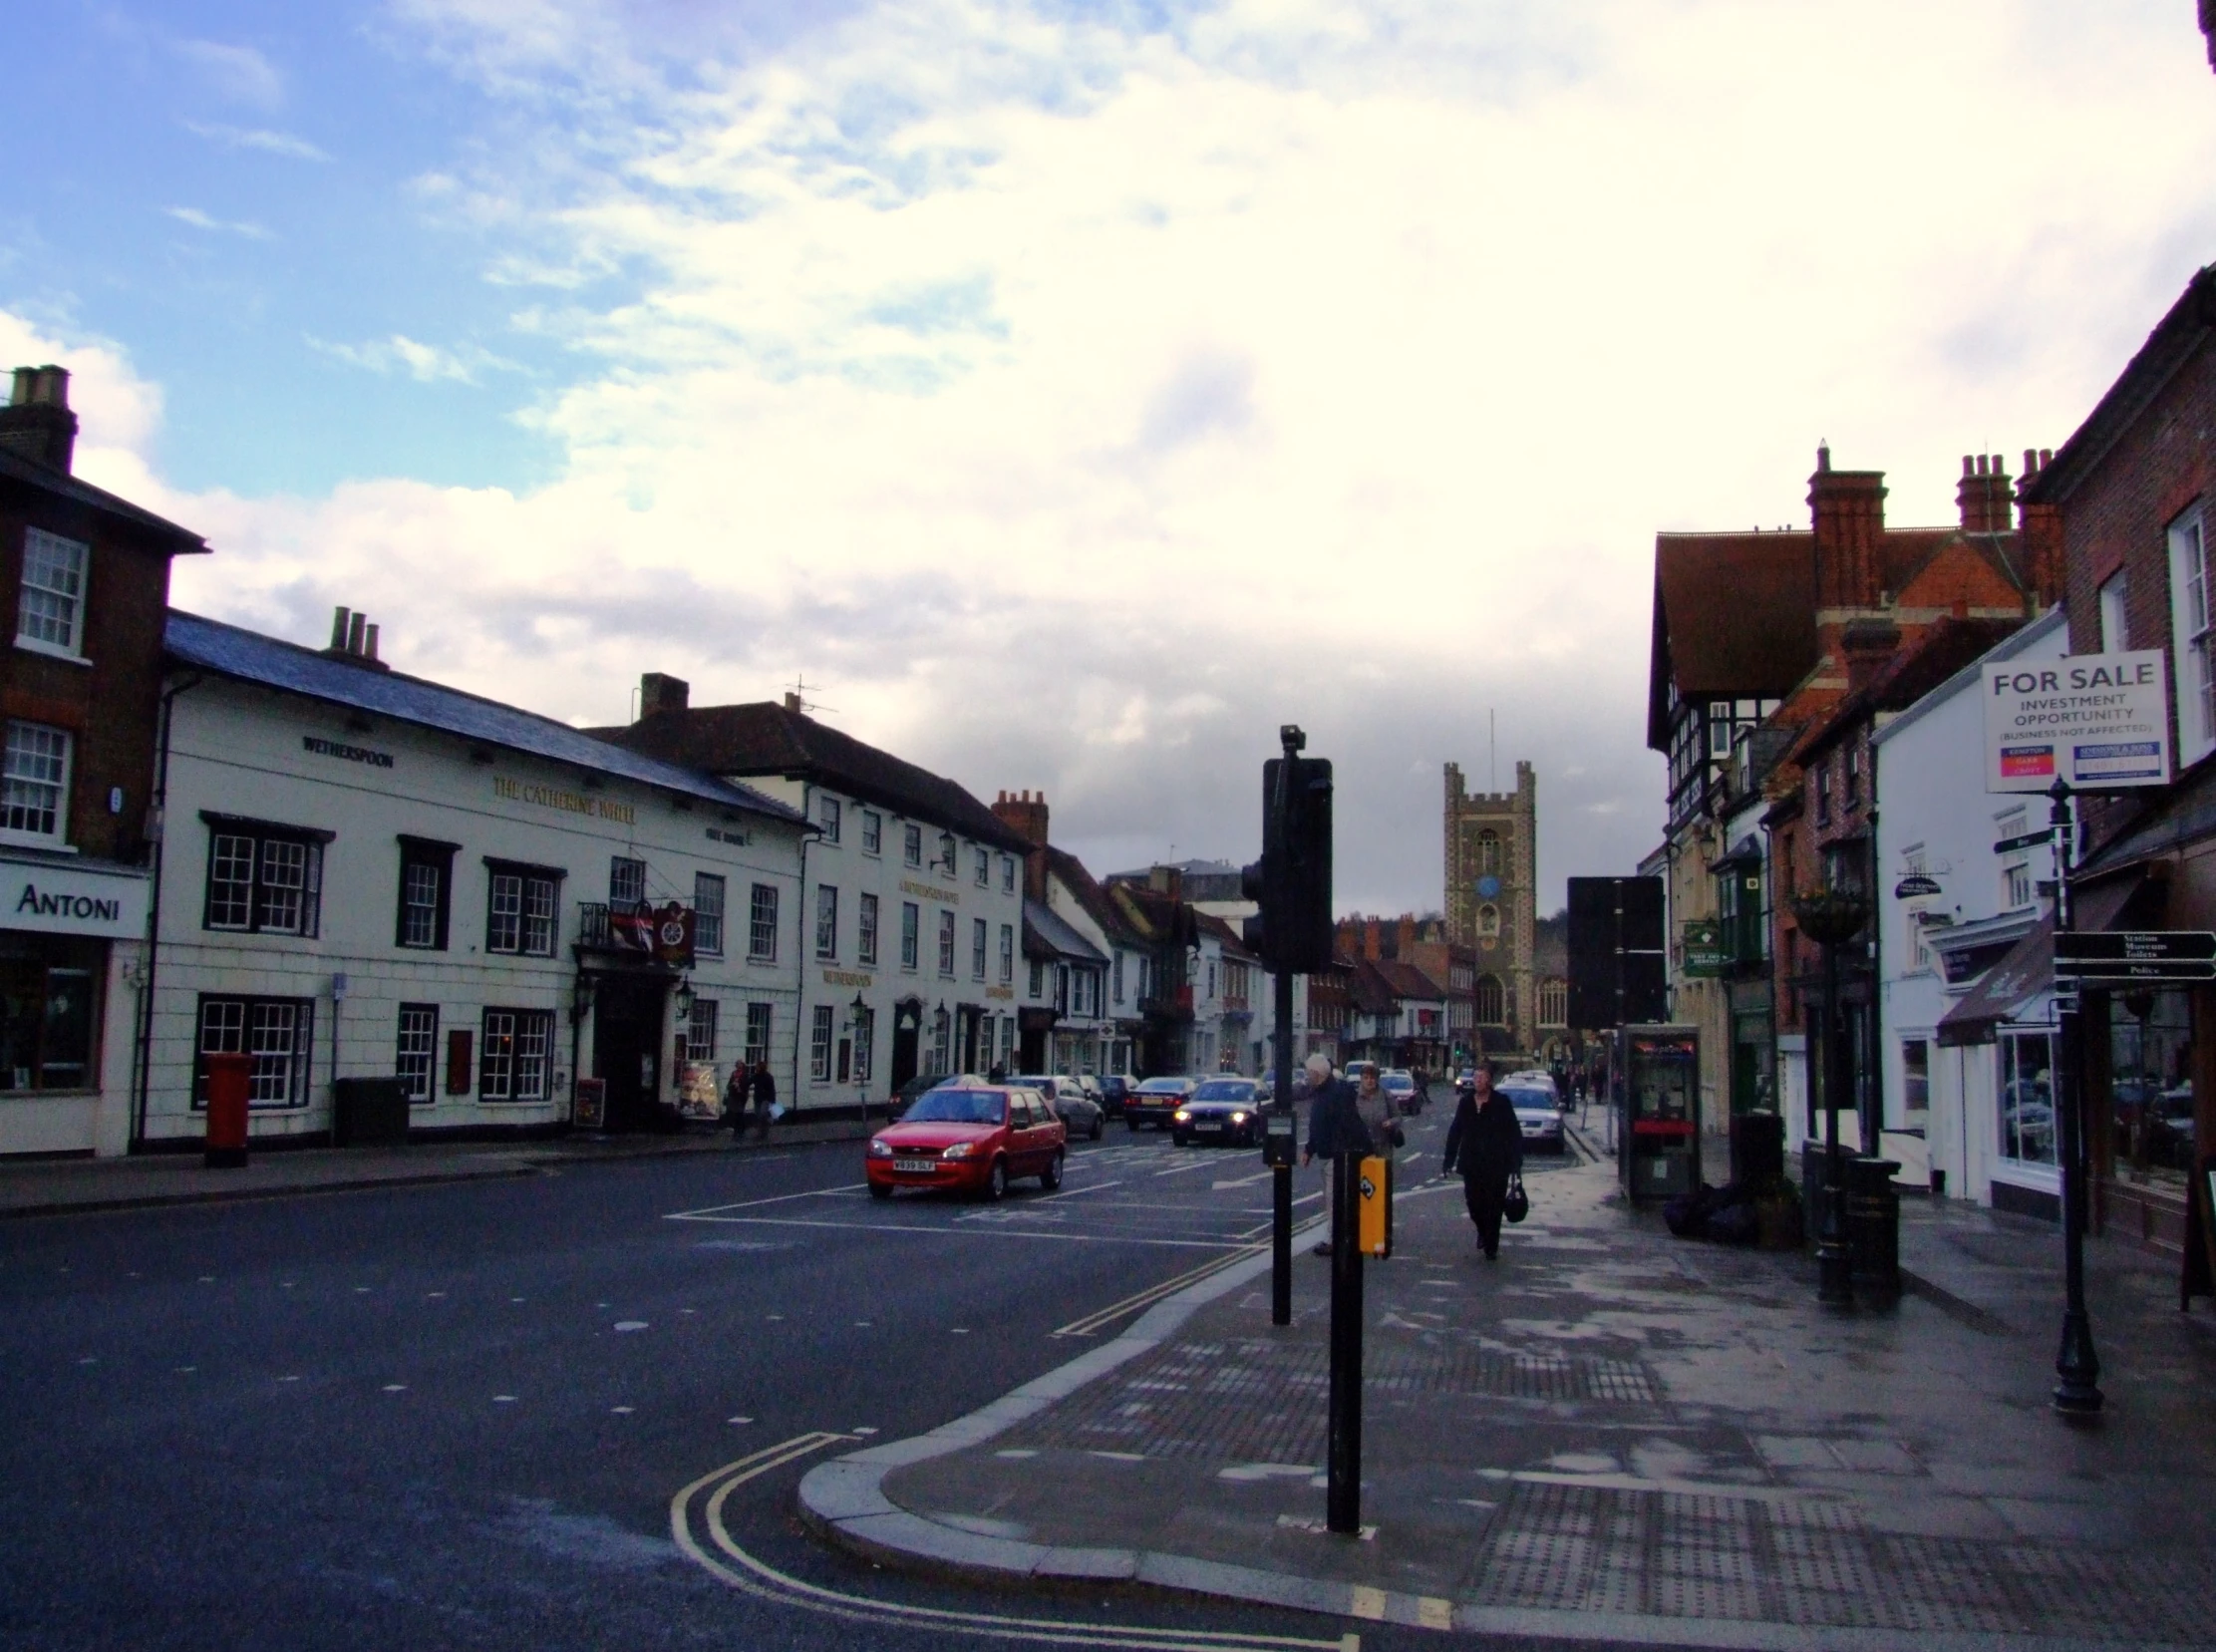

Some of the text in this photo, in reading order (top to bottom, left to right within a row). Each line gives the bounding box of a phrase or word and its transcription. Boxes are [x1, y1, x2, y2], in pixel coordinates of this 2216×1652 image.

[1994, 663, 2155, 696] FOR SALE
[2014, 708, 2134, 726] OPPORTUNITY
[2021, 694, 2127, 712] INVESTMENT
[2000, 724, 2153, 742] (BUSINESS NOT AFFECTED)
[303, 736, 394, 769] WETHERSPOON
[493, 777, 518, 801] THE
[524, 786, 595, 817] CATHERINE
[17, 883, 120, 920] ANTONI
